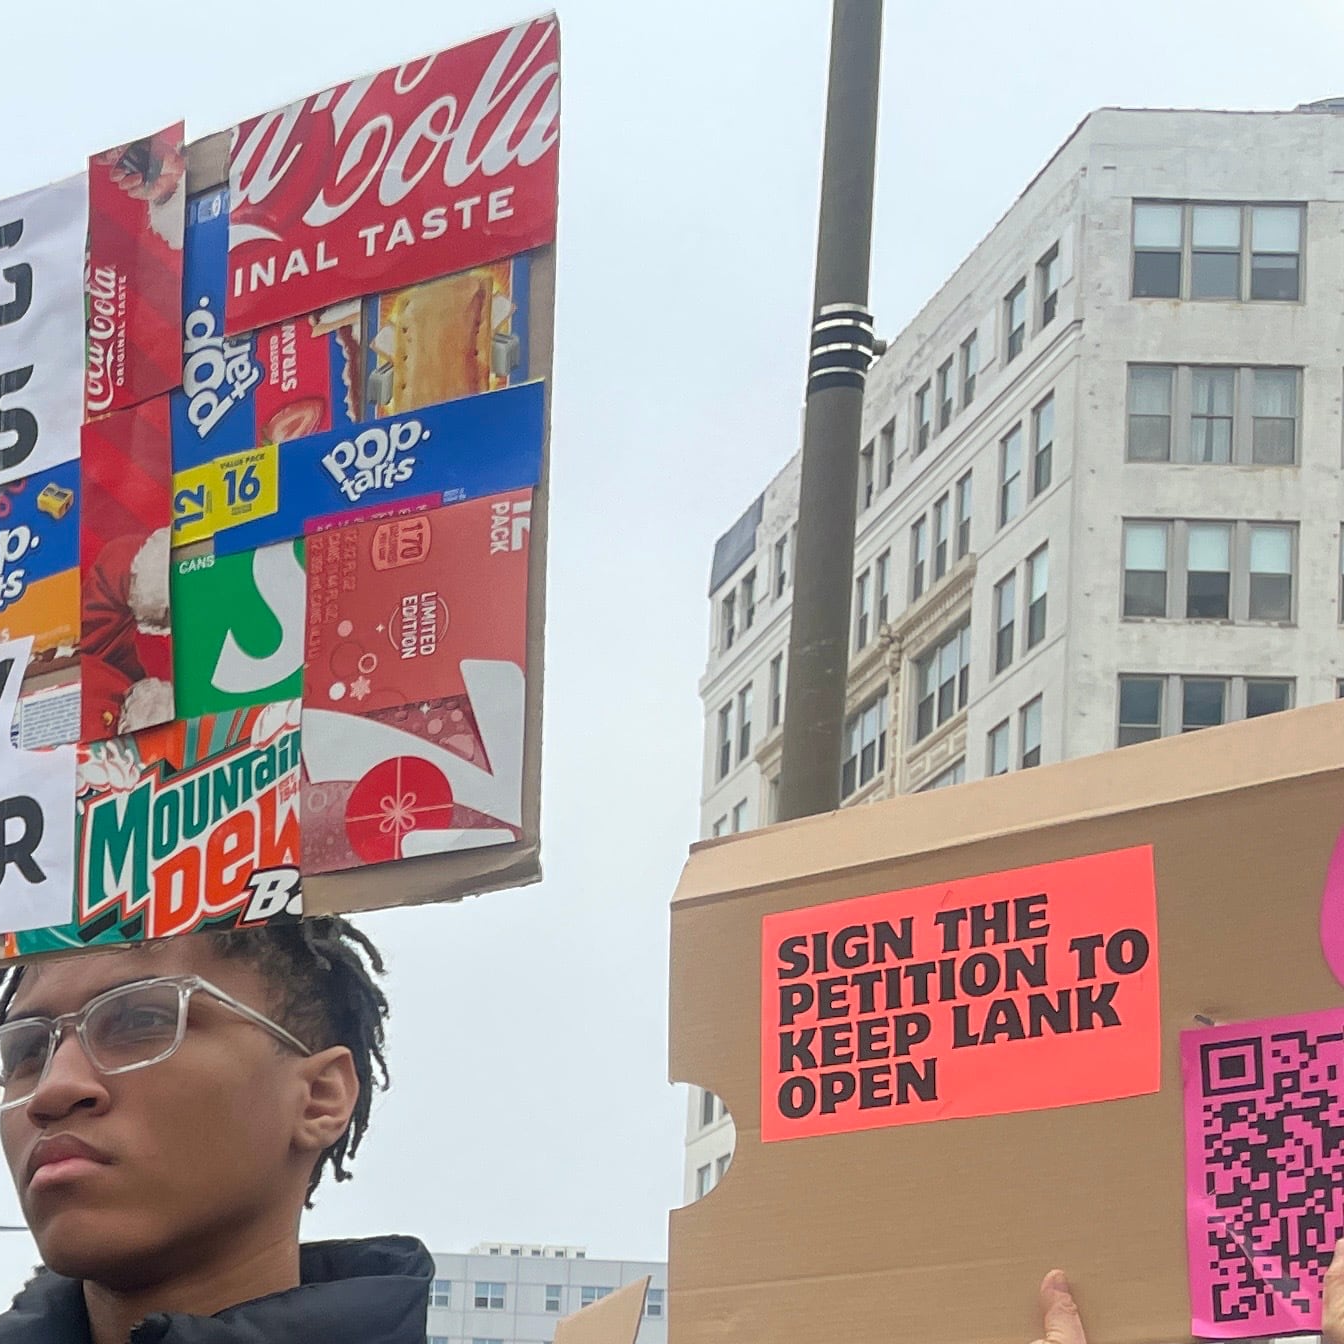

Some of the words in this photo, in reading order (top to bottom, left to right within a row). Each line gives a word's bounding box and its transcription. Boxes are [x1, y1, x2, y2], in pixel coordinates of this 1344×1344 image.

[233, 250, 338, 299] INAL
[359, 188, 515, 253] TASTE
[220, 457, 245, 470] VALUE
[246, 453, 266, 464] PACK
[223, 465, 261, 505] 16
[174, 485, 205, 531] 12
[491, 501, 509, 556] PACK
[179, 554, 215, 574] CANS
[400, 522, 423, 559] 170
[401, 594, 418, 660] EDITION
[420, 591, 438, 656] LIMITED
[777, 917, 913, 981] SIGN
[933, 893, 1051, 953] THE
[779, 944, 1048, 1026] PETITION
[1069, 928, 1150, 982] TO
[779, 1011, 931, 1074] KEEP
[952, 983, 1122, 1050] LANK
[777, 1057, 938, 1119] OPEN
